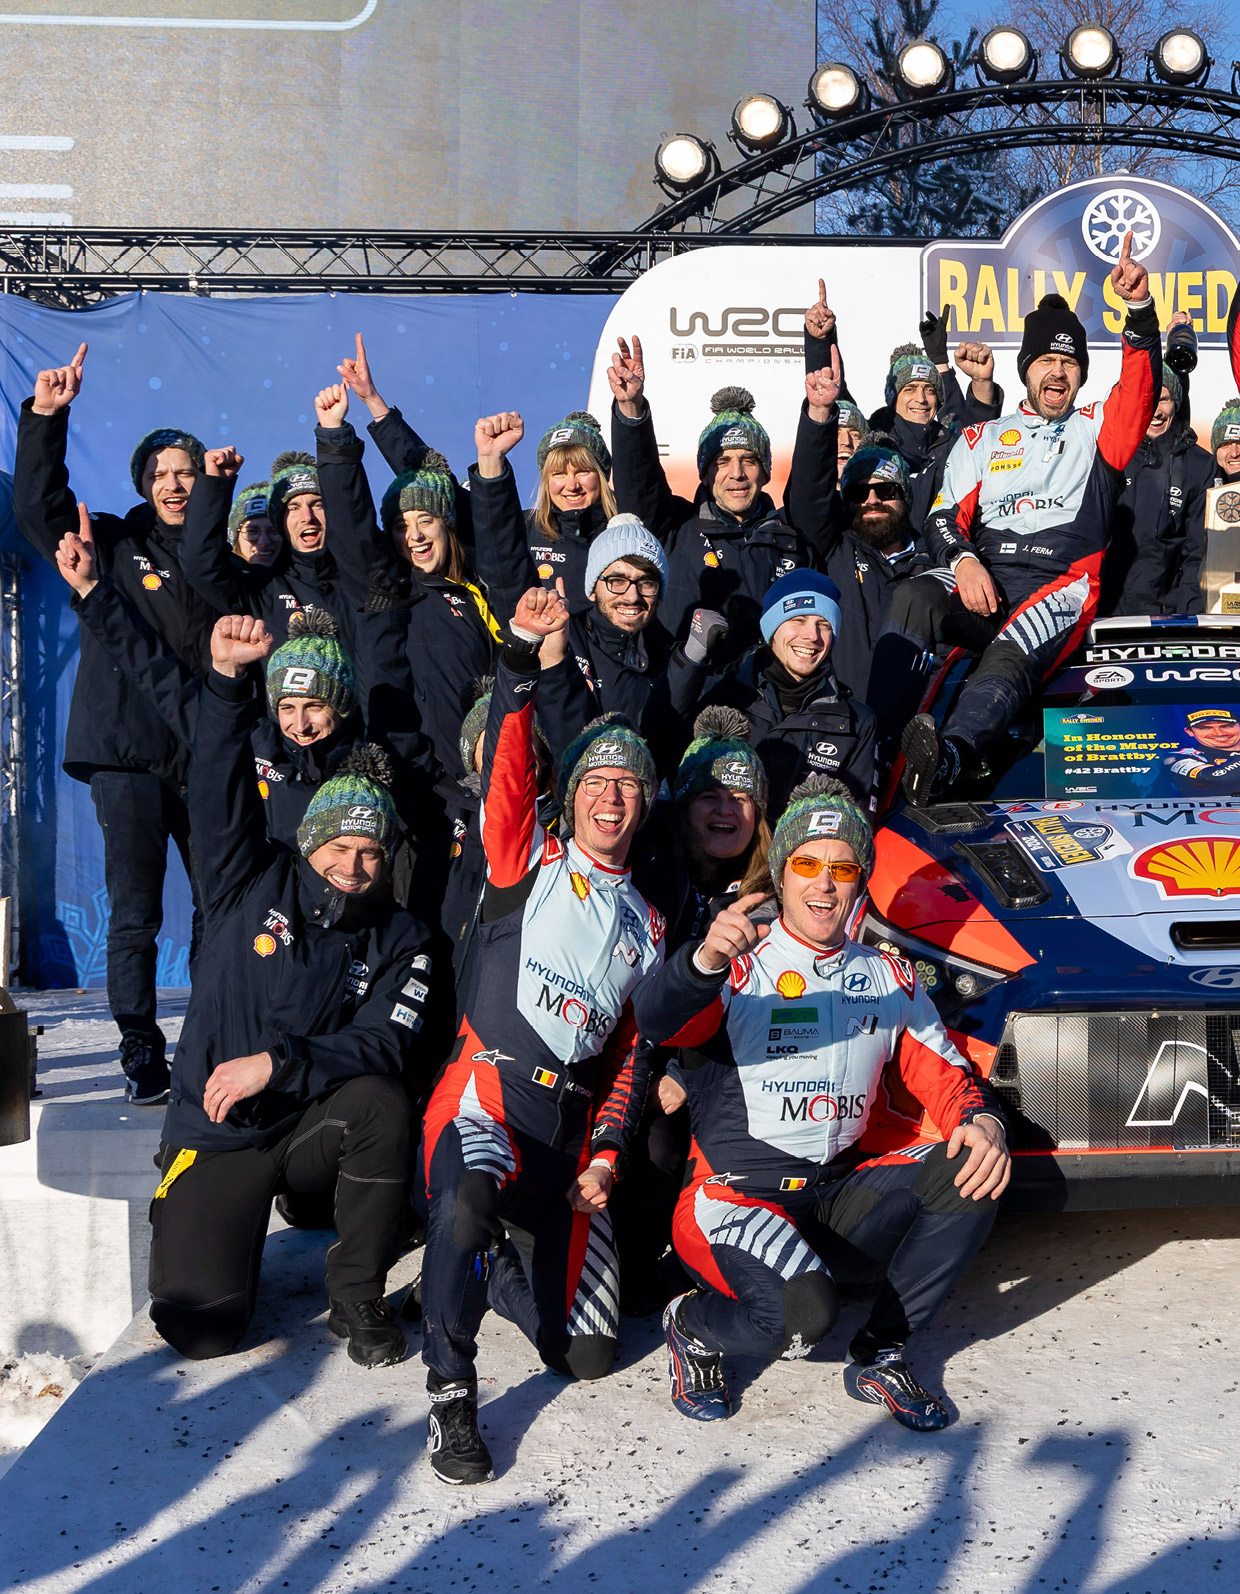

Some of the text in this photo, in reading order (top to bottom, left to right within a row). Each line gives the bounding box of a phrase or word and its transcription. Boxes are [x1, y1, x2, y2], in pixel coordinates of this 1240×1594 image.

[939, 258, 1087, 334] RALLY
[706, 347, 721, 356] FIA
[727, 347, 769, 356] WORLD
[1031, 546, 1054, 556] FERM
[535, 552, 566, 564] MOBIS
[1086, 733, 1157, 742] Honour
[1064, 741, 1180, 753] of the Mayor
[588, 755, 626, 764] HYUNDAI
[807, 752, 841, 768] HYUNDAI
[1064, 752, 1160, 764] of Brattby.
[1065, 765, 1150, 776] #42 Brattby
[1021, 835, 1044, 853] 2024
[1031, 816, 1097, 865] RALLY SWEDEN
[263, 916, 294, 946] MOBIS
[525, 957, 592, 1003] HYUNDAI
[842, 995, 880, 1005] HYUNDAI
[536, 983, 612, 1040] MOBIS
[783, 1028, 820, 1036] BAUMA
[767, 1045, 799, 1055] LKQ
[766, 1054, 787, 1063] Keeping
[800, 1054, 818, 1062] moving
[762, 1080, 836, 1094] HYUNDAI
[780, 1093, 867, 1123] MOBIS
